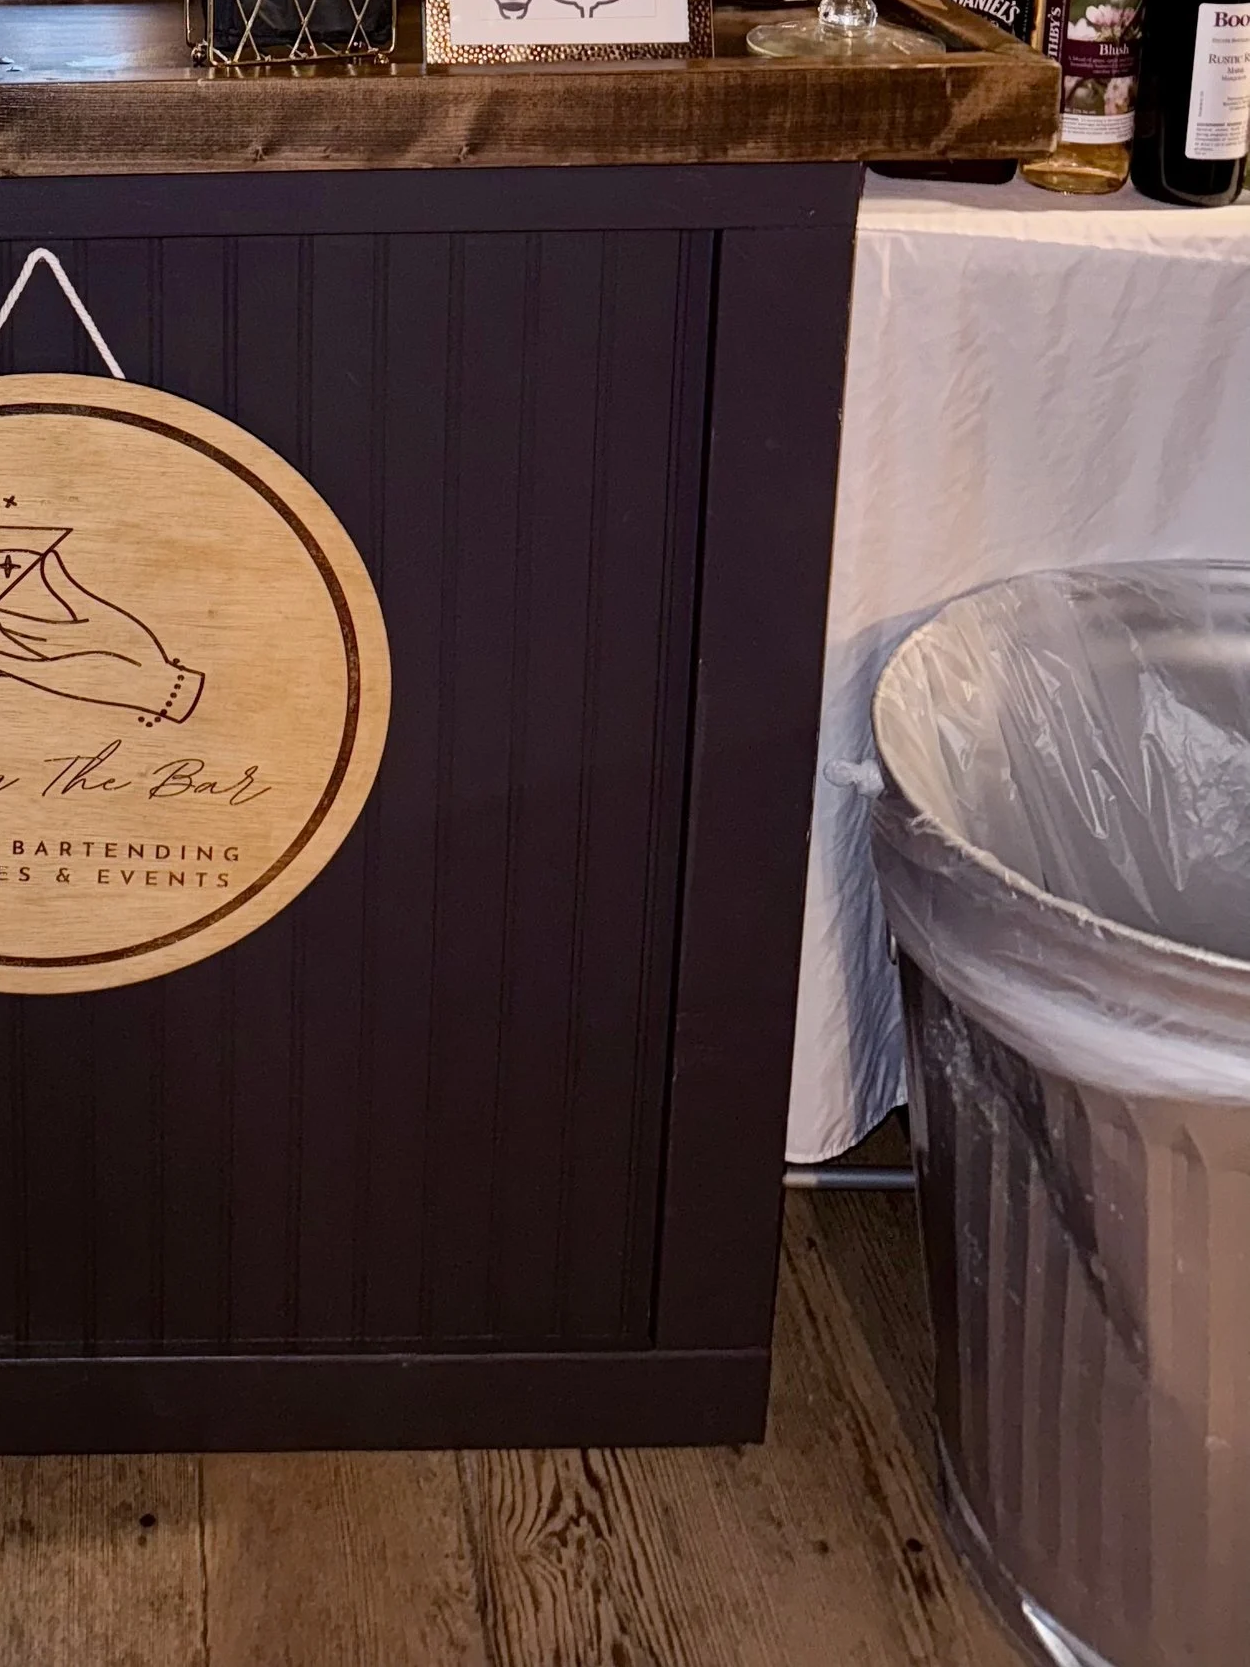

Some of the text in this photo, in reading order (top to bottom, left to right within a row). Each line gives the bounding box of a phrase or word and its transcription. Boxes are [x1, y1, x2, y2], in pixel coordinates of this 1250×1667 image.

[1047, 6, 1061, 58] THBY'S
[1099, 43, 1130, 56] Blush
[41, 739, 133, 797] The
[148, 758, 273, 806] Bar
[12, 839, 242, 862] BARTENDING
[55, 866, 71, 884] &
[97, 868, 230, 888] EVENTS
